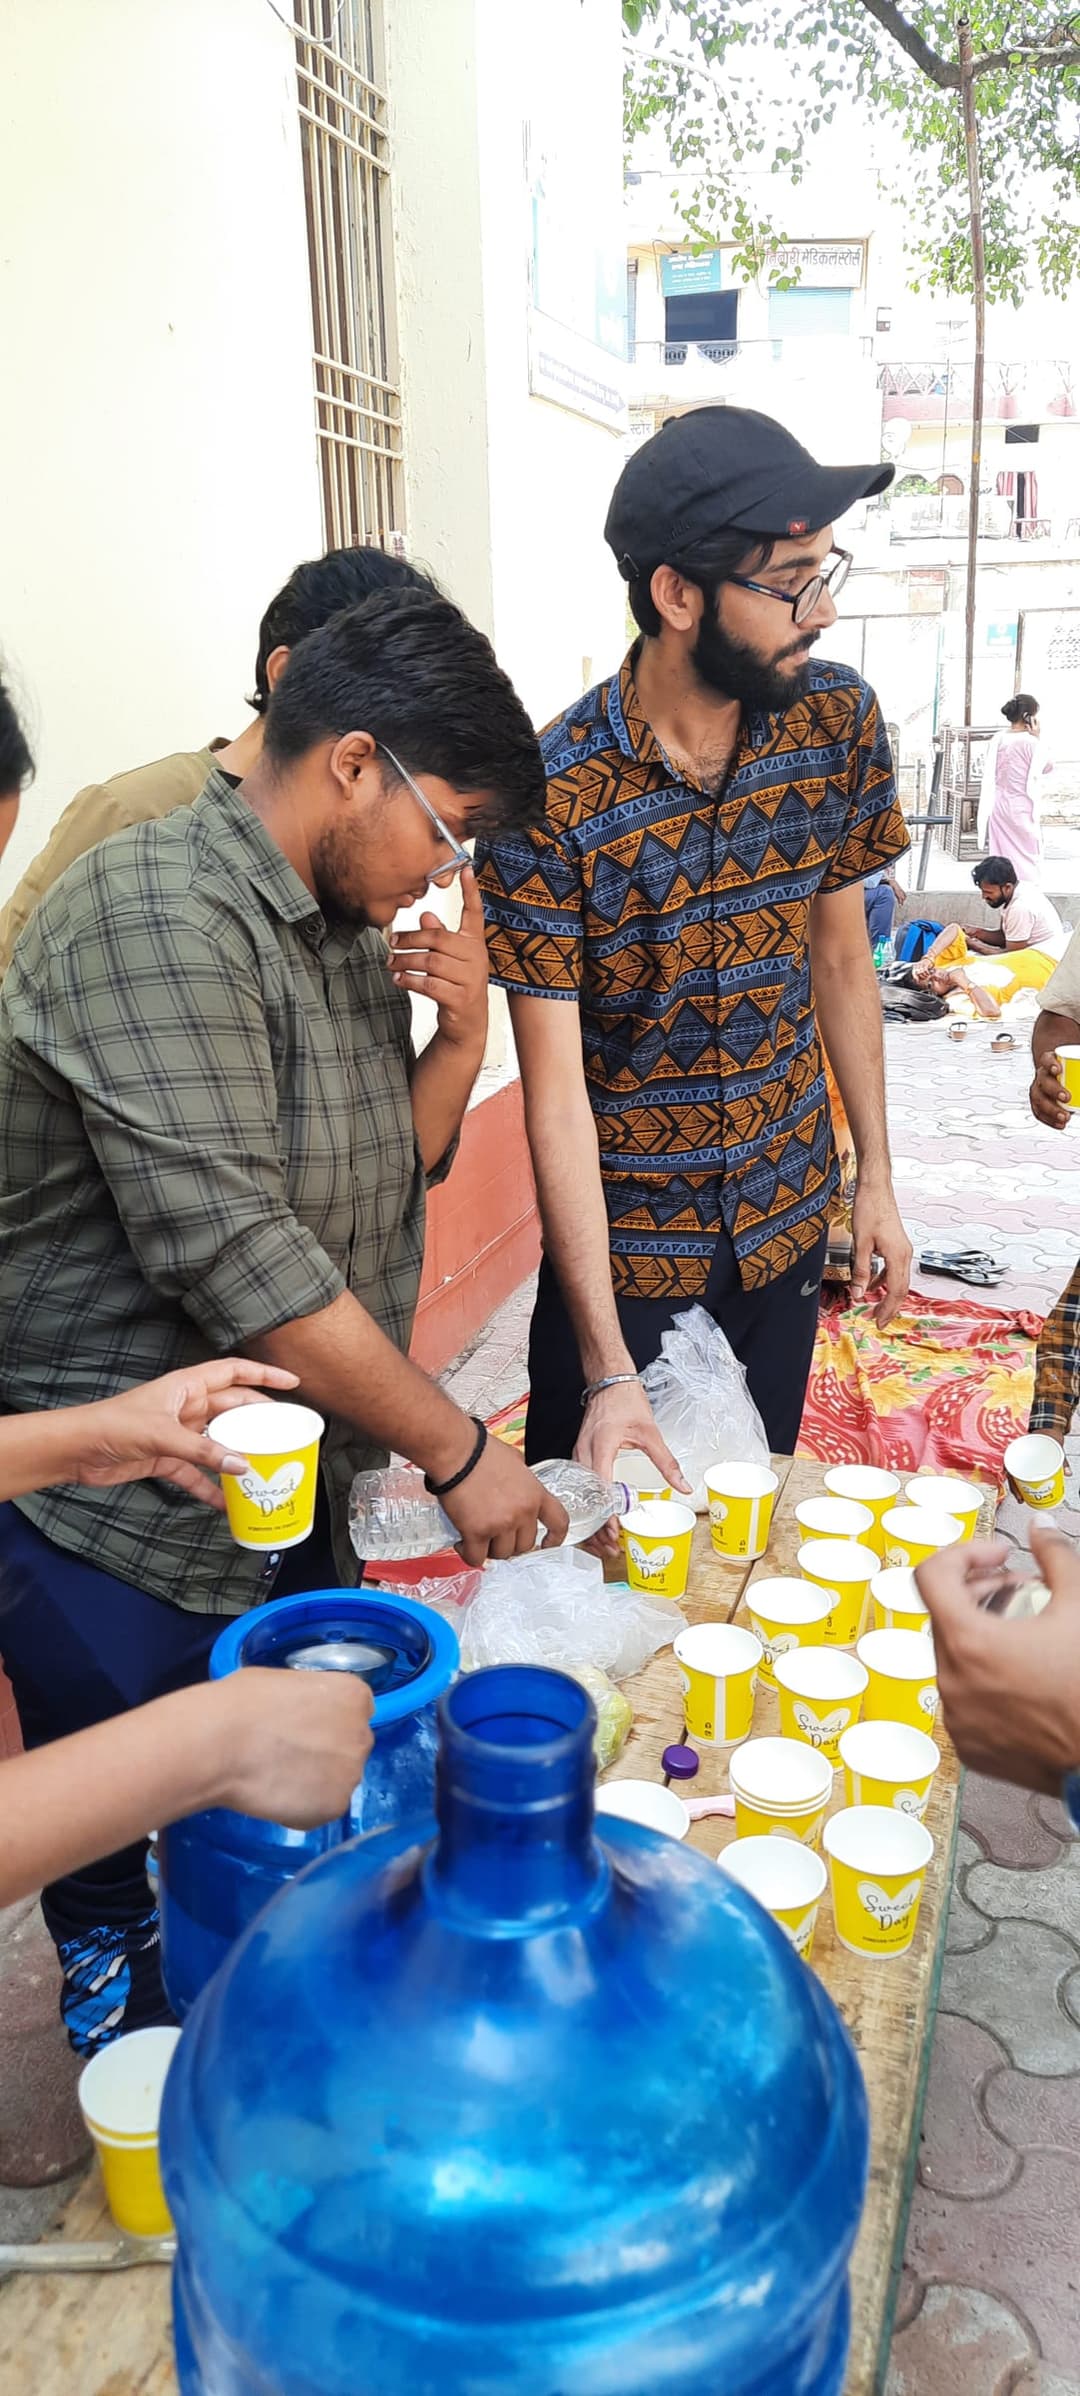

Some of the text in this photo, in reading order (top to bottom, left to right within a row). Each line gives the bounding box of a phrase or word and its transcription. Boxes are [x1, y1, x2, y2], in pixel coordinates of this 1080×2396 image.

[242, 1477, 297, 1499] Sweet
[259, 1497, 296, 1517] Day
[631, 1548, 669, 1567] Sweet
[640, 1565, 665, 1584] Day
[798, 1713, 843, 1733] Sweet
[810, 1733, 839, 1751] Day
[863, 1893, 914, 1913] Sweet
[879, 1913, 910, 1931] Day
